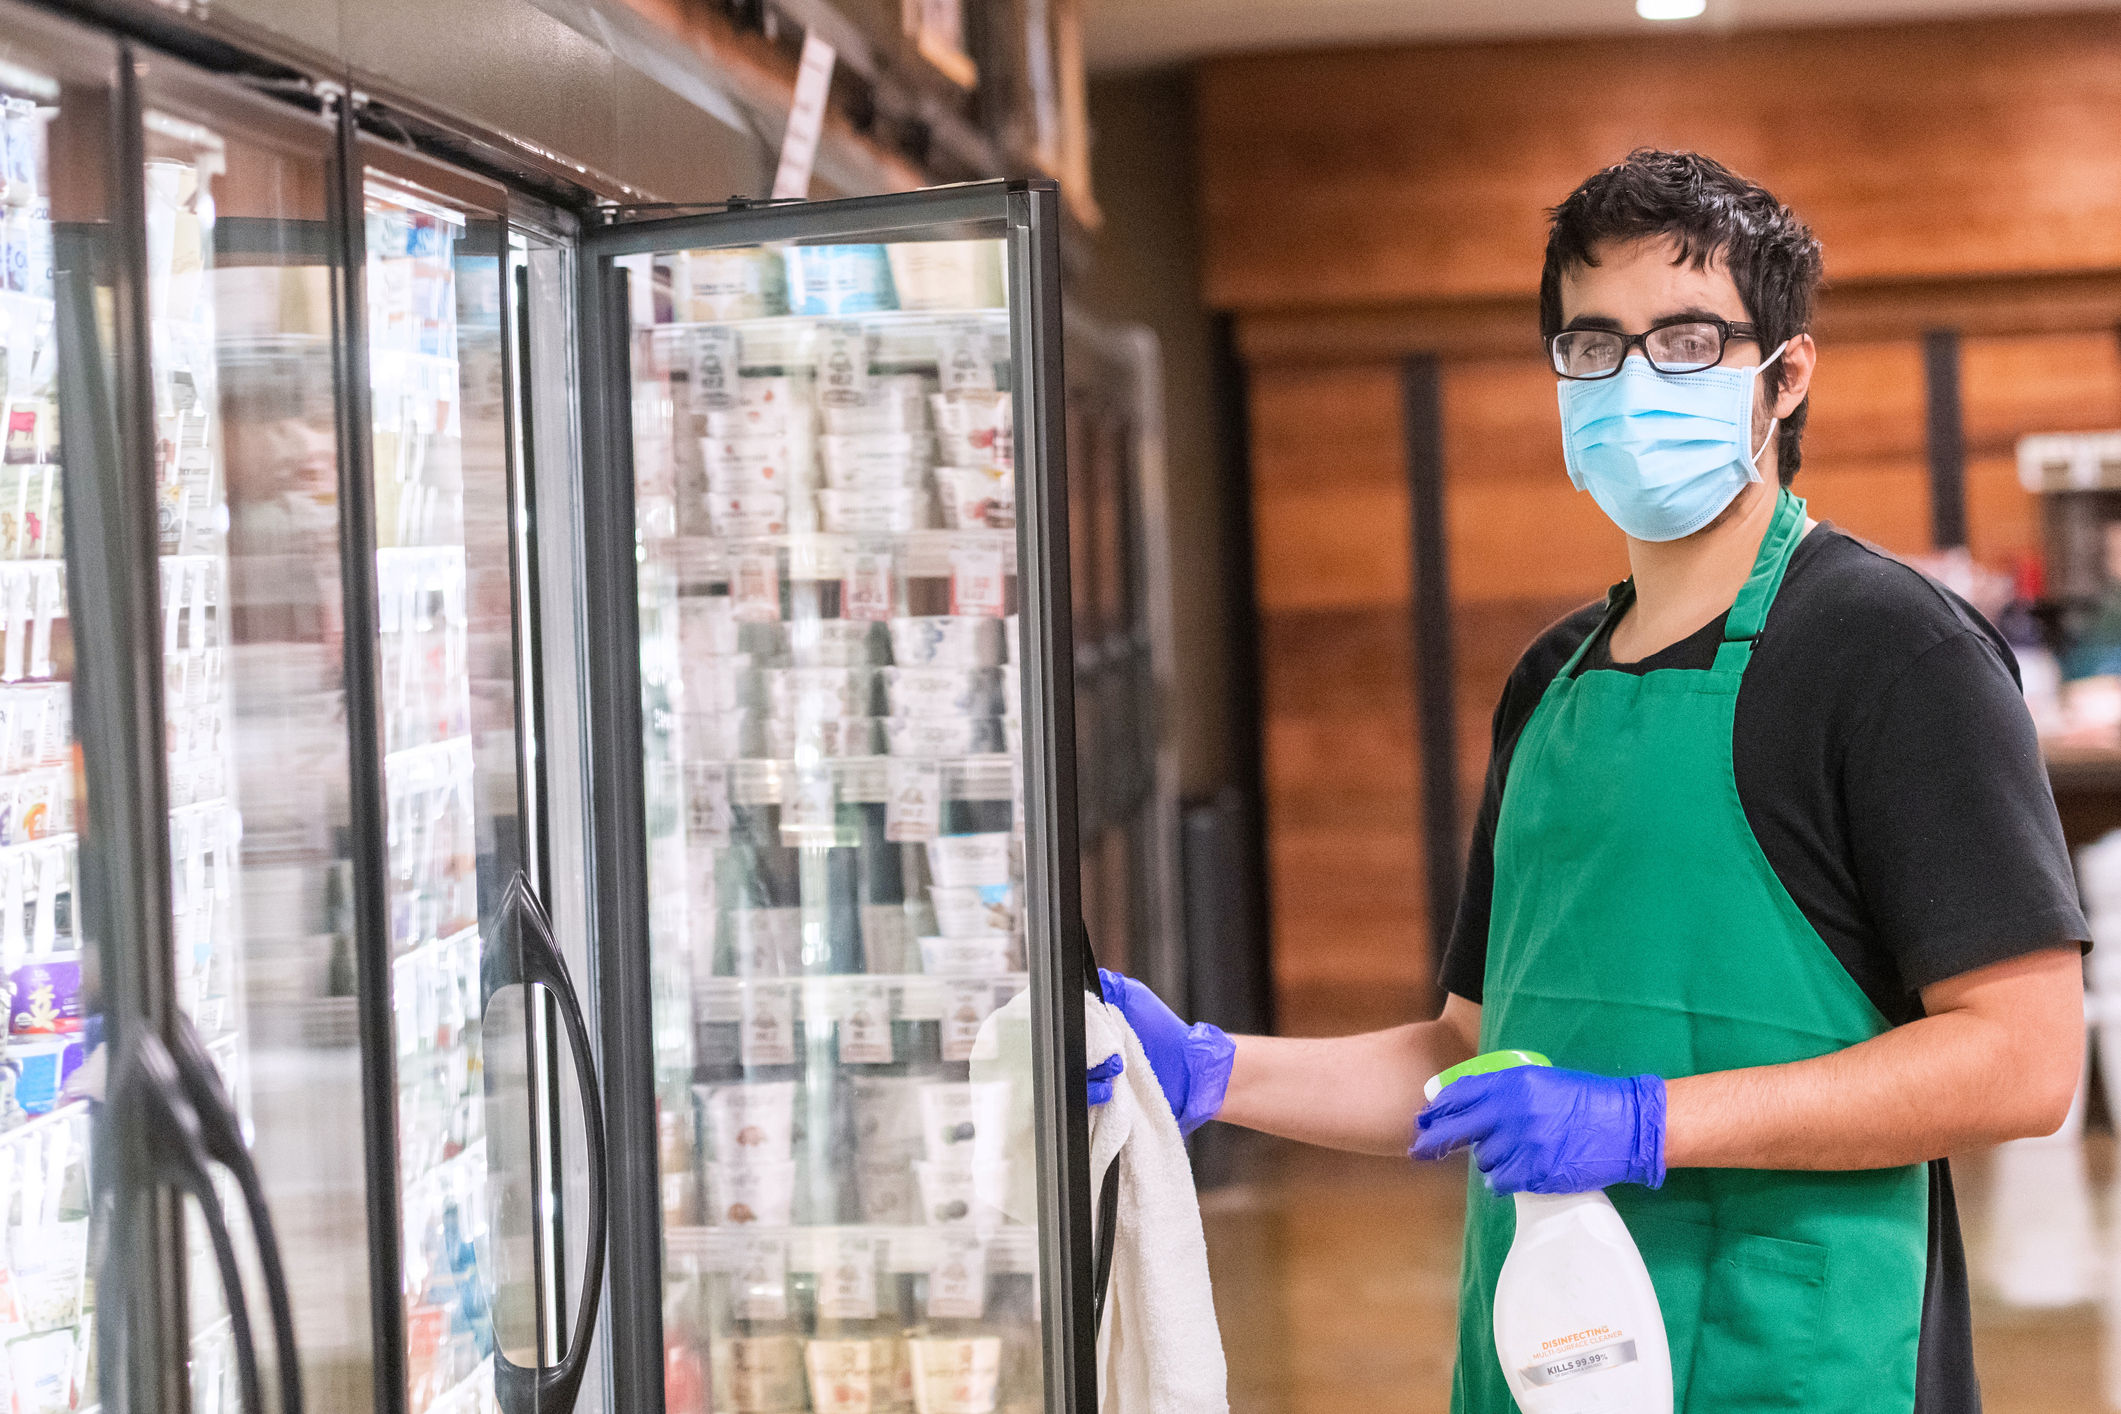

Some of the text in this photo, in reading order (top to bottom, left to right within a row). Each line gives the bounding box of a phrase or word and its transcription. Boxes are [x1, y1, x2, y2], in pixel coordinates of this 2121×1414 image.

[1532, 1330, 1623, 1360] MULTI-SURFACE CLEANER
[1541, 1326, 1609, 1350] DISINFECTING
[1547, 1354, 1608, 1375] KILLS 99.99%
